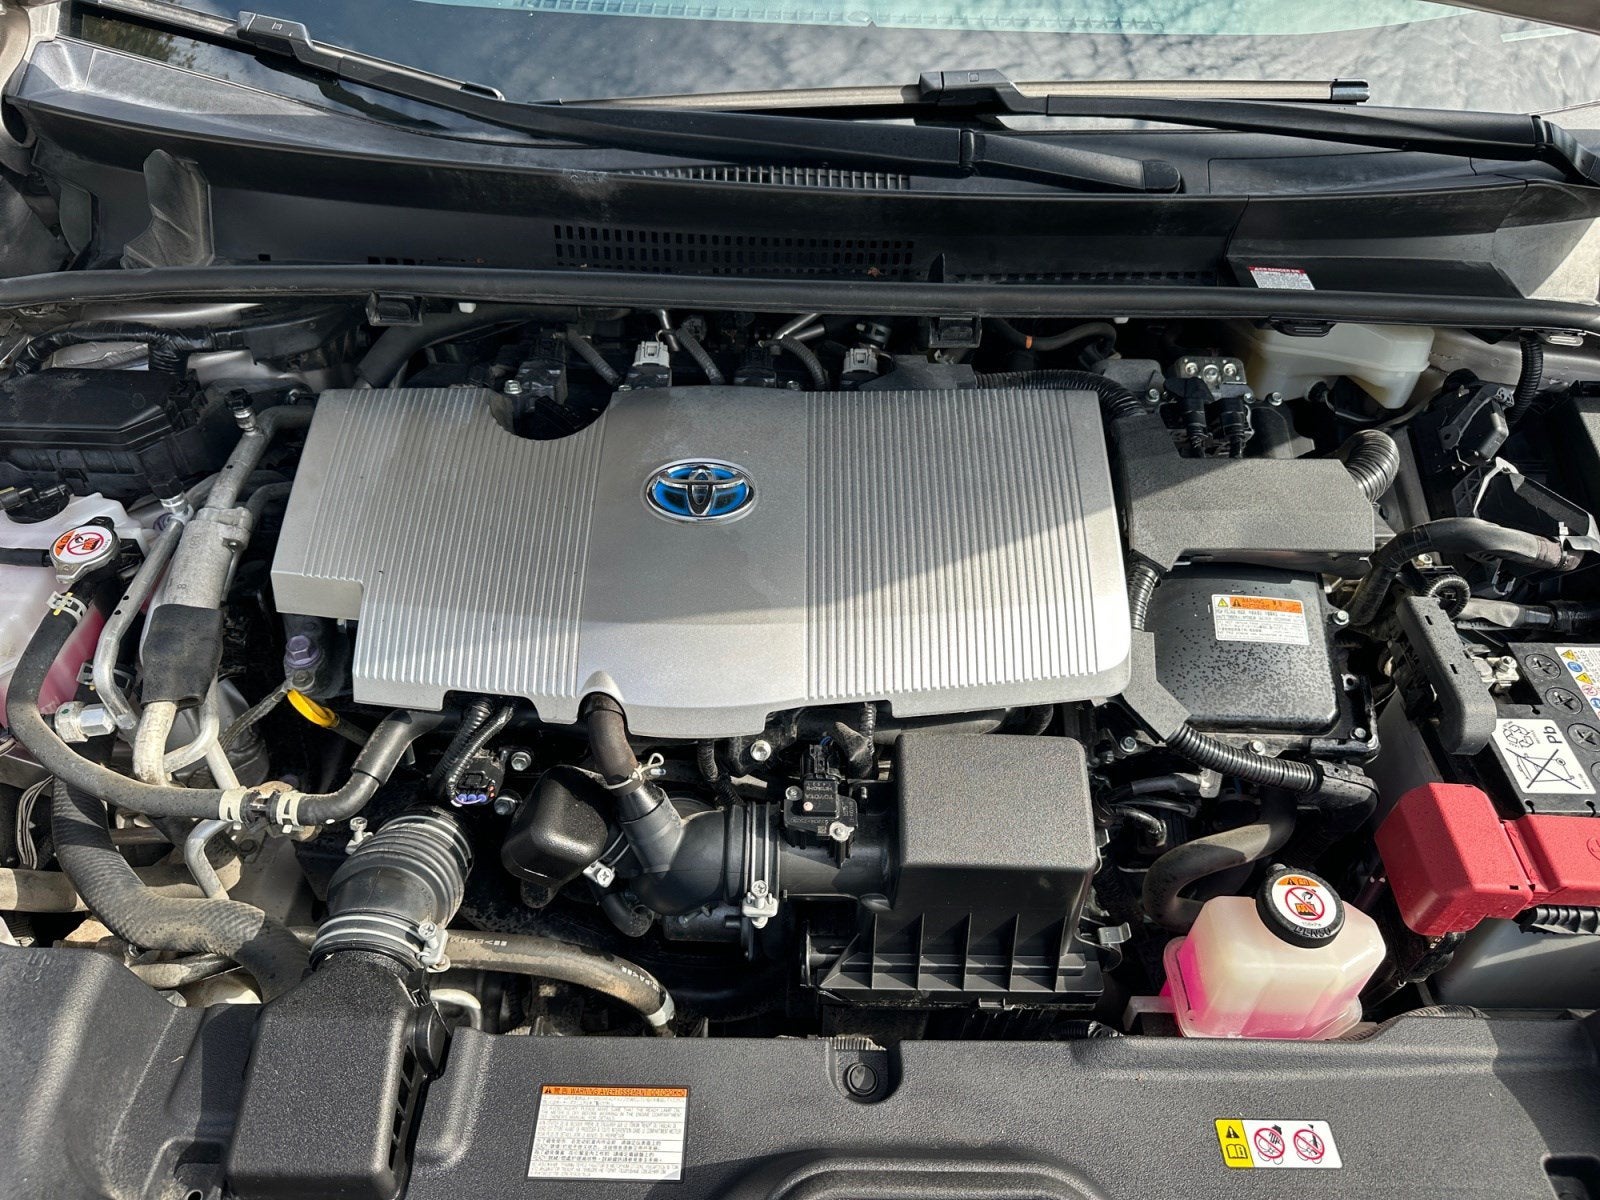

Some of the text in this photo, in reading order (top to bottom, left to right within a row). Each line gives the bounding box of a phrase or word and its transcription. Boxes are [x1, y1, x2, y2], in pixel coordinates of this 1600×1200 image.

[1543, 726, 1562, 743] Pb
[1294, 926, 1331, 937] DENSO
[570, 1087, 599, 1095] WARNING
